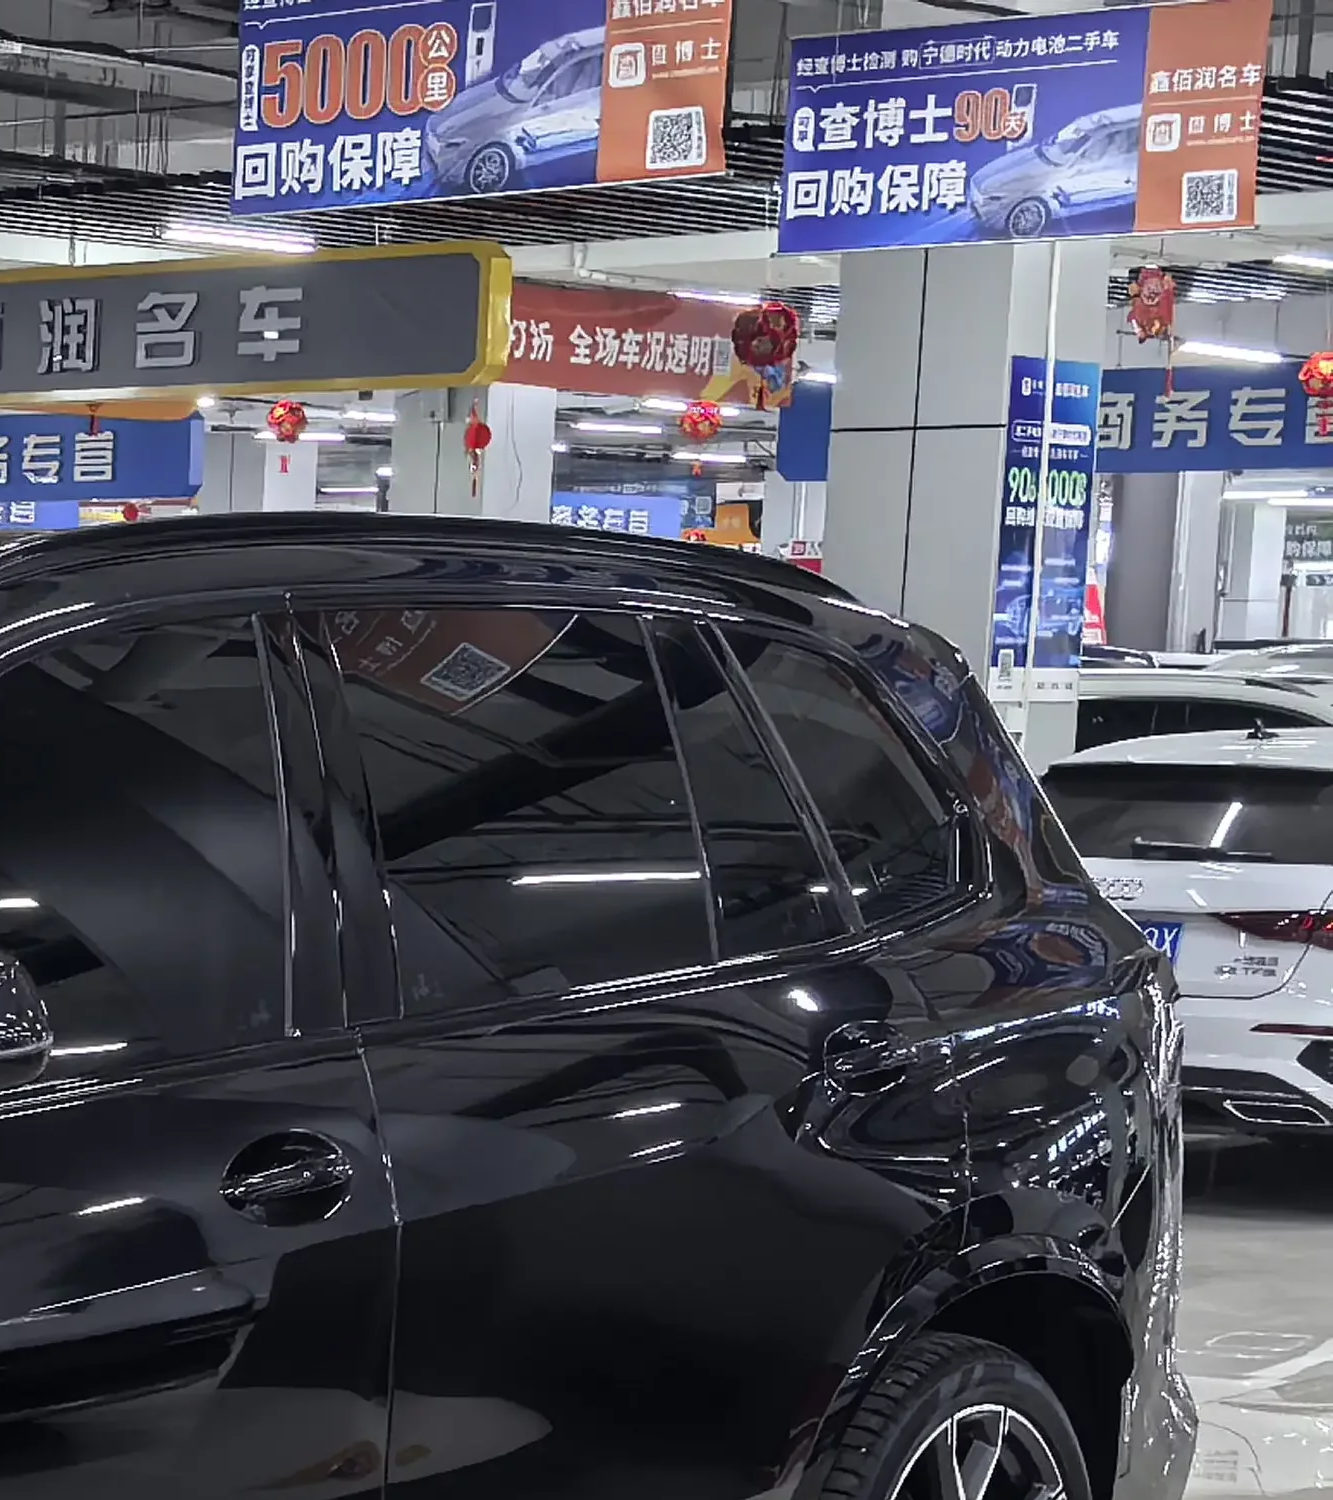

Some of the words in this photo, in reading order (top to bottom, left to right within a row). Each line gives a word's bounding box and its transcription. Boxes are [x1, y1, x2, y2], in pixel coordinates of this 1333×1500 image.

[996, 30, 1120, 58] 动力电池二手车
[261, 24, 427, 128] 5000
[424, 29, 451, 102] 公里
[1149, 63, 1262, 95] 鑫佰润名车
[817, 94, 952, 151] 查博士
[953, 87, 1011, 143] 90
[235, 127, 422, 200] 回购保障
[786, 158, 969, 221] 回购保障
[568, 323, 711, 377] 全场车况透明
